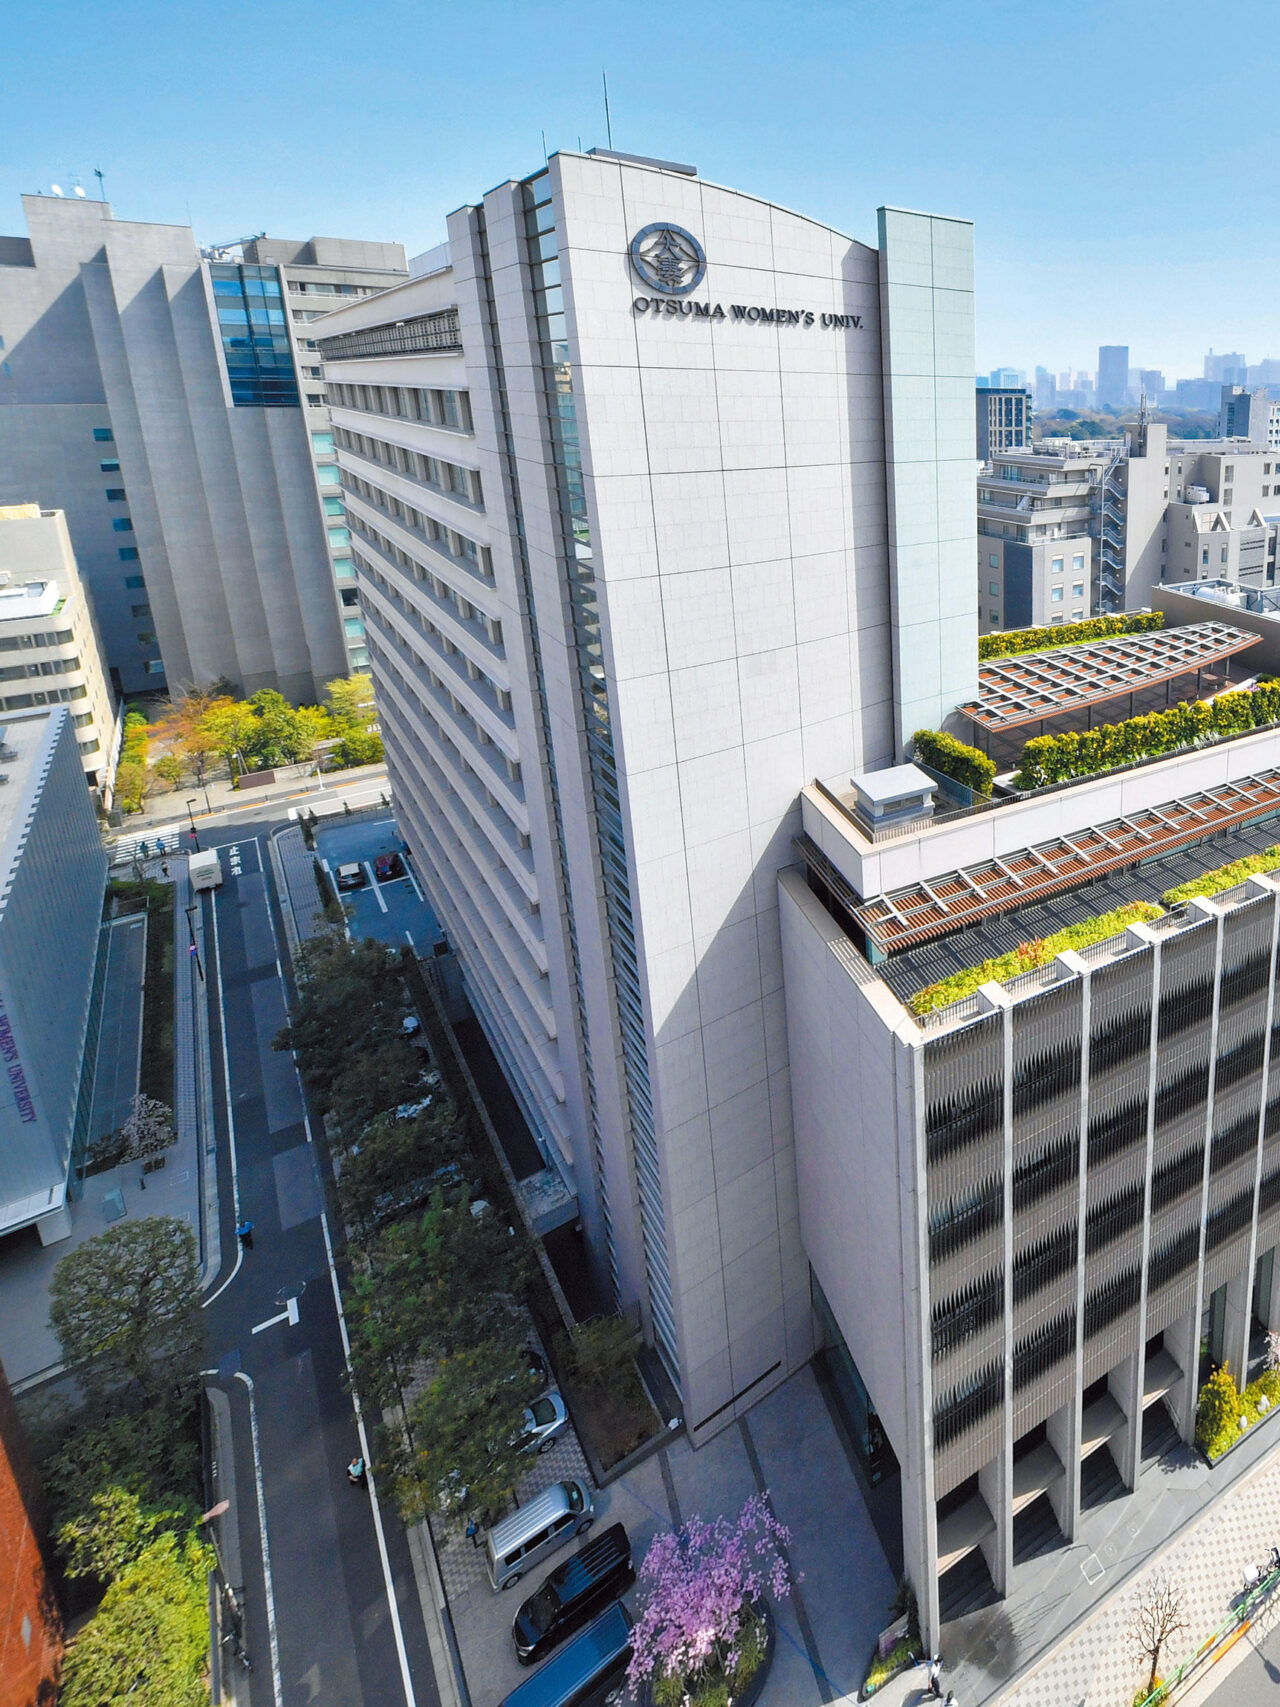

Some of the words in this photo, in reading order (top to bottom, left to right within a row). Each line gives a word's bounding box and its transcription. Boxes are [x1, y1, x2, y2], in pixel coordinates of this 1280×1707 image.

[634, 296, 727, 319] OTSUMA
[731, 303, 815, 325] WOMEN'S
[821, 312, 864, 329] UNIV.
[8, 1064, 37, 1124] UNIVERSITY
